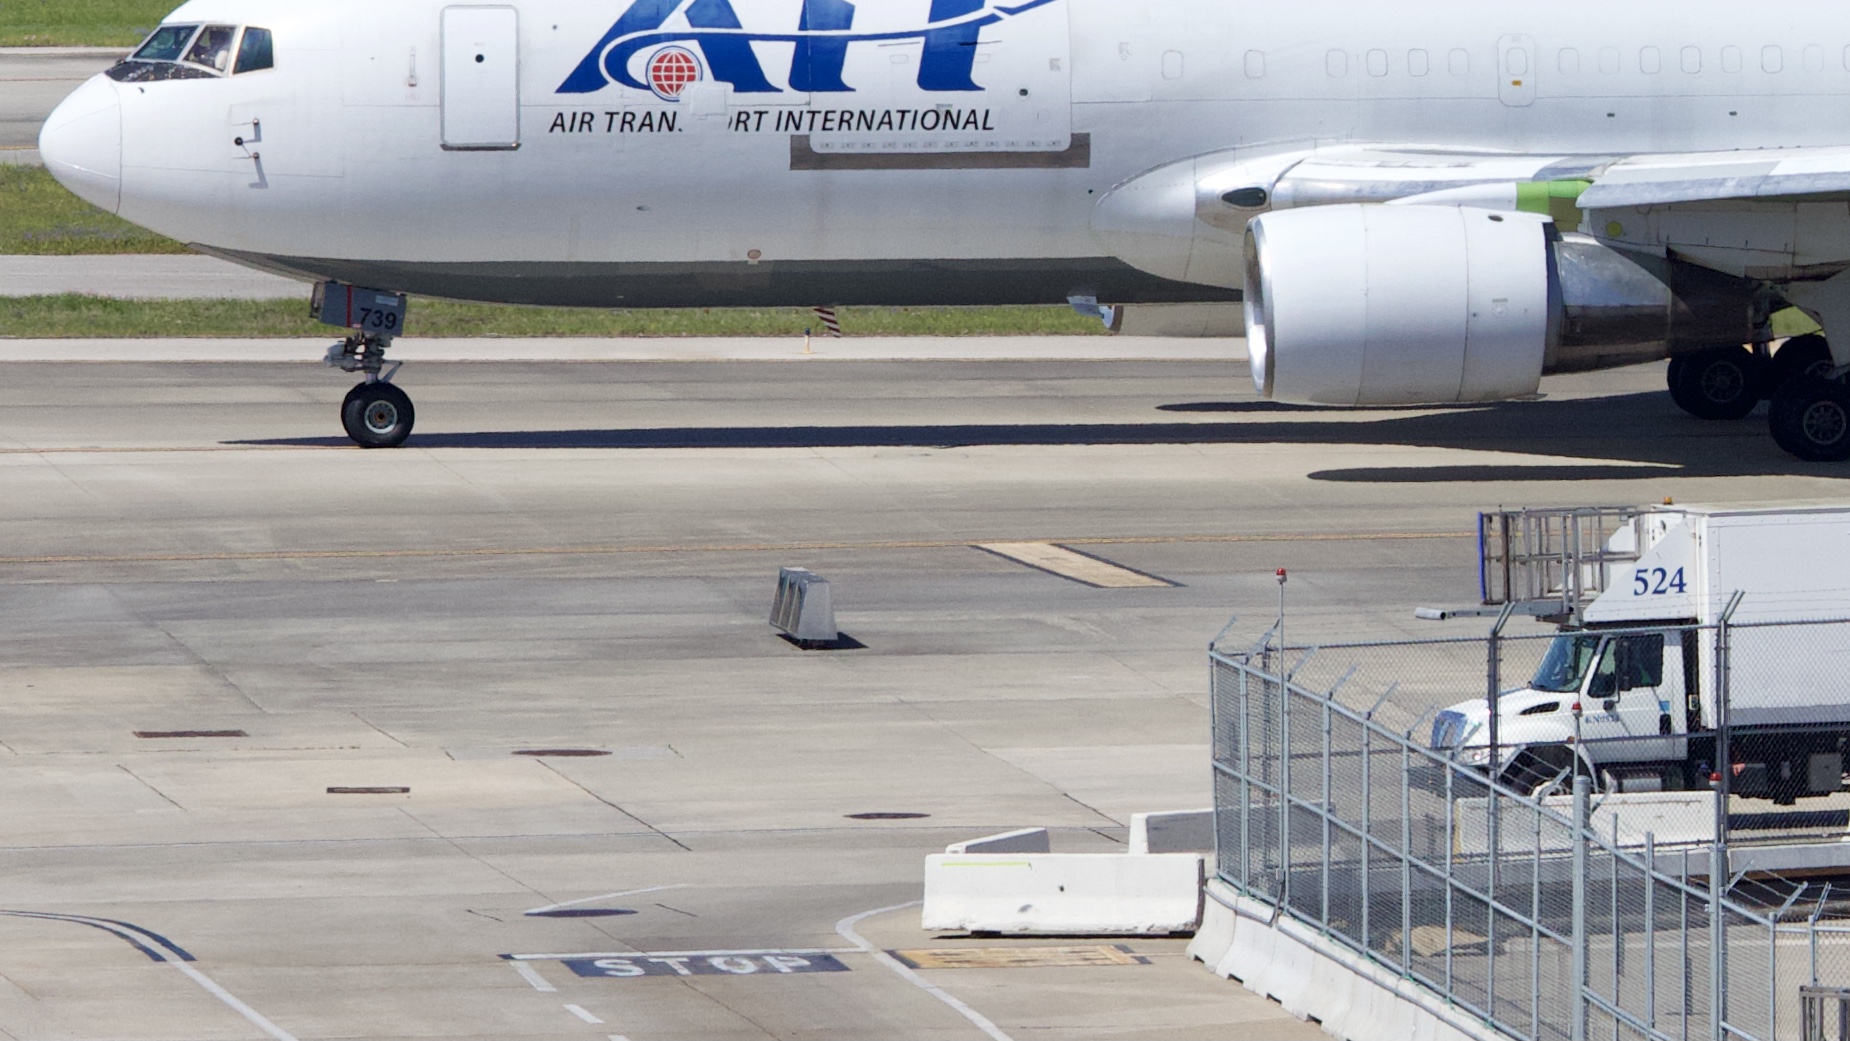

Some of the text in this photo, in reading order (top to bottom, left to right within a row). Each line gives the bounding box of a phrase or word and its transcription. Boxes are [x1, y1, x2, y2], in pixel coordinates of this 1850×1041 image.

[549, 109, 994, 133] AIR TRANRT INTERNATIONAL
[360, 307, 397, 330] 739
[1633, 566, 1688, 596] 524
[593, 954, 812, 978] STOP
